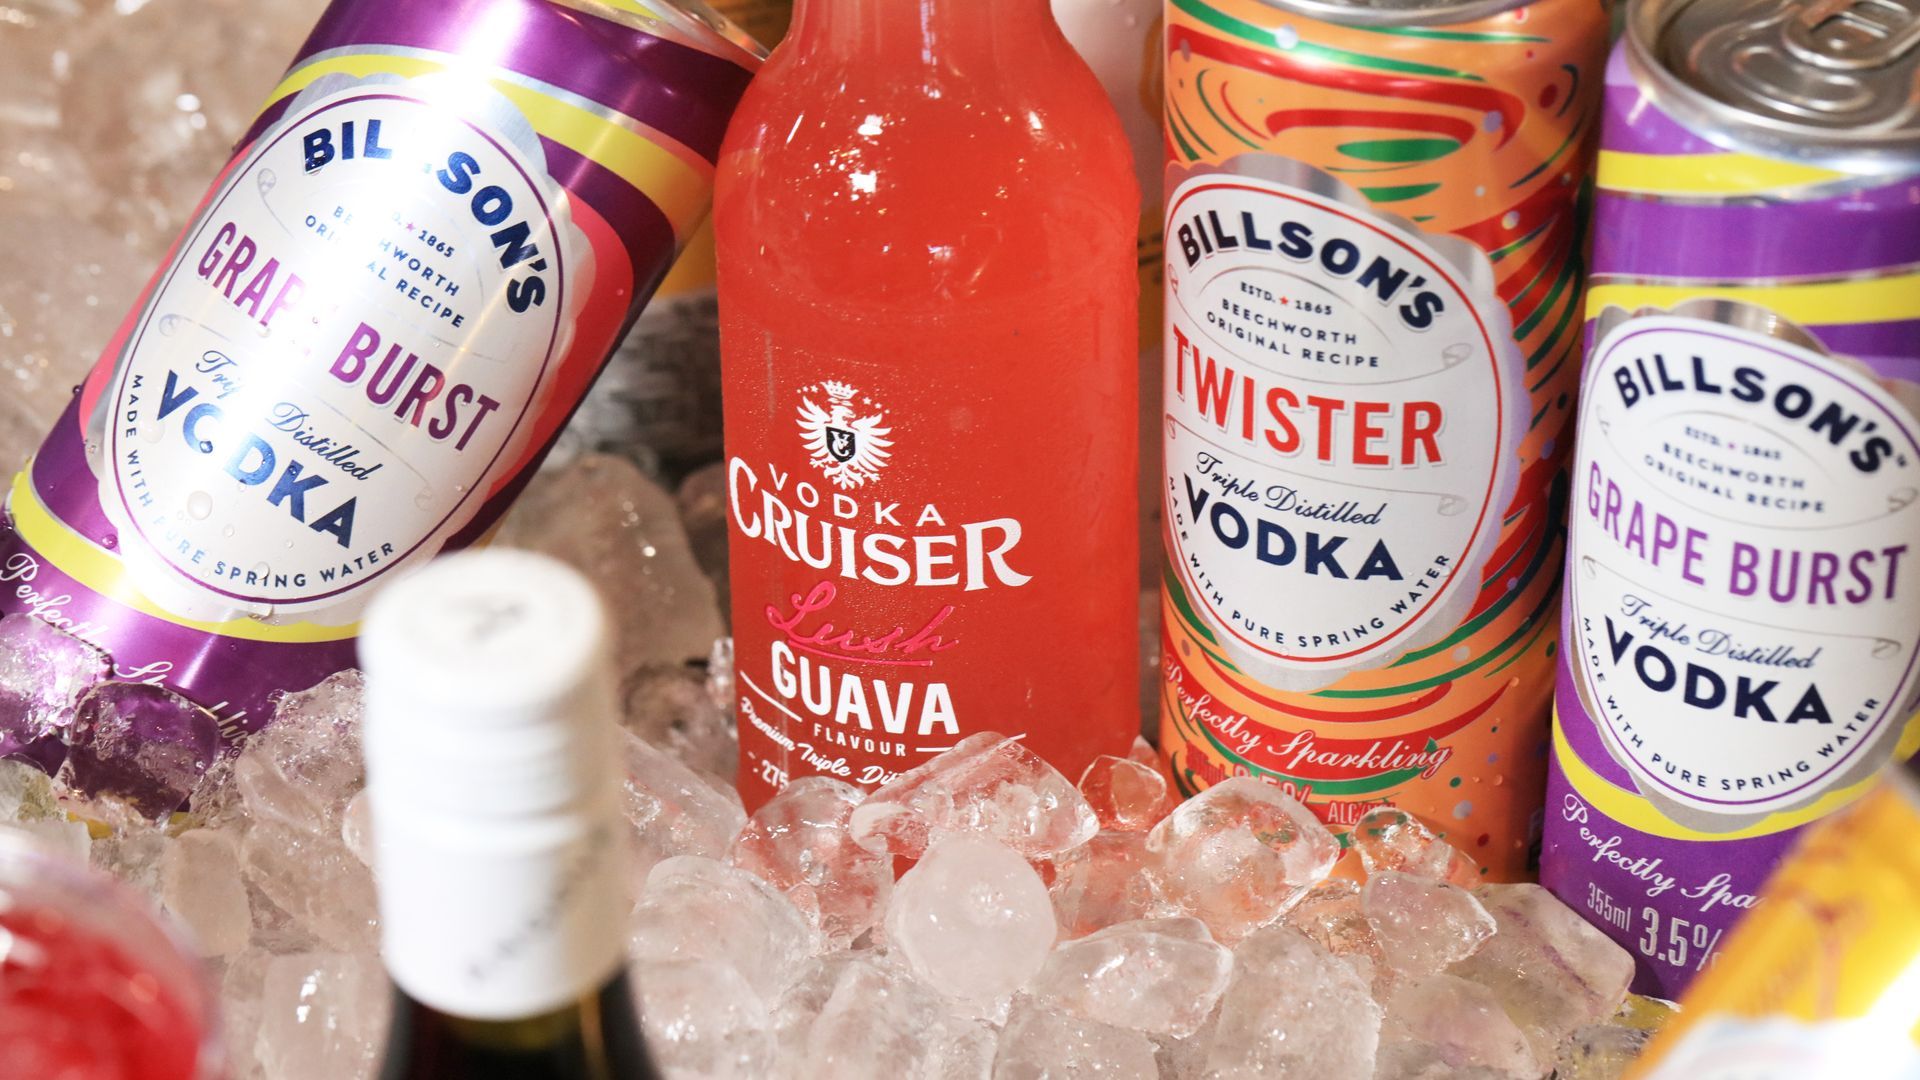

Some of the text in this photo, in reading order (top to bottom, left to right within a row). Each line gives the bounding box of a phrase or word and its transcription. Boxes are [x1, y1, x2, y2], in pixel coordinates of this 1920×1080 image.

[303, 118, 548, 313] BILSON'S
[333, 205, 460, 297] BEHWORTH
[417, 229, 455, 258] 1865
[396, 278, 465, 328] RECIPE
[1177, 209, 1445, 329] BILLSON'S
[1240, 281, 1333, 316] ESTD. 1865
[197, 221, 501, 452] GRAP BURST
[1207, 311, 1379, 368] ORIGINAL RECIPE
[1221, 298, 1357, 345] BEECHWORTH
[125, 374, 144, 438] MADE
[1172, 323, 1443, 466] TWISTER
[1613, 354, 1893, 474] BILLSON'S
[126, 449, 154, 508] WITH
[265, 402, 383, 482] Distilled
[1663, 442, 1805, 489] BEECHWORTH
[768, 463, 946, 527] VODKA
[1196, 451, 1388, 525] Triple Distilled
[1644, 454, 1824, 512] ORIGINAL RECIPE
[319, 542, 394, 583] WATER
[729, 456, 1034, 592] CRUISER
[1169, 476, 1450, 649] MADE WITH PURE SPRING WATER
[1183, 472, 1404, 581] VODKA
[1587, 460, 1909, 605] GRAPE BURST
[214, 561, 307, 588] SPRING
[766, 580, 960, 653] Lush
[1620, 594, 1823, 669] Triple Distilled
[771, 640, 960, 736] GUAVA
[1583, 617, 1880, 791] MADE WITH PURE SPRING WATER
[1604, 614, 1833, 724] VODKA
[740, 696, 796, 752] Premium
[797, 742, 852, 777] Triple
[813, 722, 906, 757] FLAVOUR
[1166, 655, 1262, 755] Perfectly
[1267, 731, 1451, 778] Sparkling
[1562, 793, 1675, 897] Perfectly
[1587, 882, 1631, 932] 355ml
[1638, 907, 1723, 972] 3.5%
